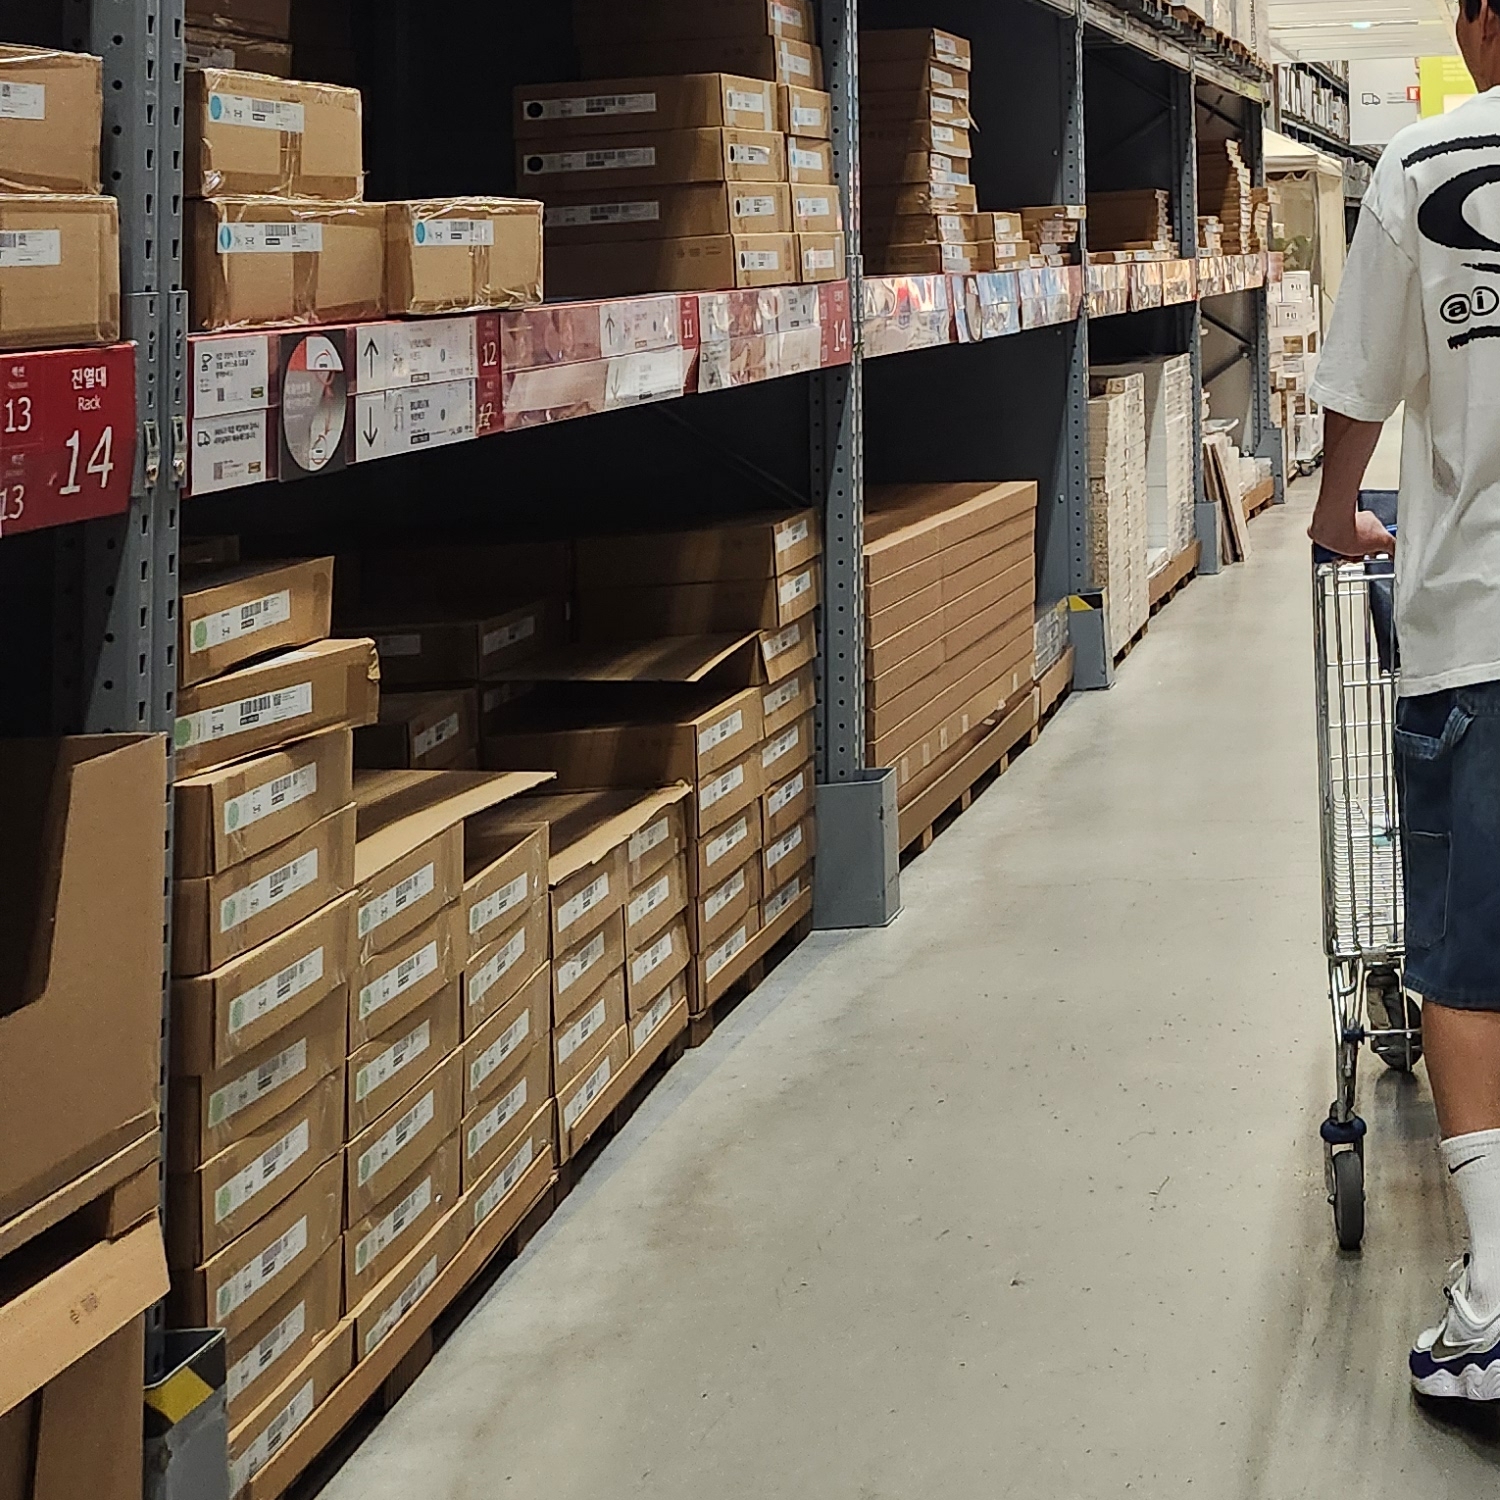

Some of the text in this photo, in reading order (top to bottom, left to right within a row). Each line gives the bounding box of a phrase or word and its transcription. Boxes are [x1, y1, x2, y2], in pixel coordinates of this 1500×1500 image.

[833, 318, 848, 353] 14
[482, 341, 497, 367] 12
[71, 365, 108, 391] 진열대
[4, 396, 32, 433] 13
[77, 395, 101, 412] Rack
[59, 426, 114, 495] 14
[0, 485, 25, 522] 13
